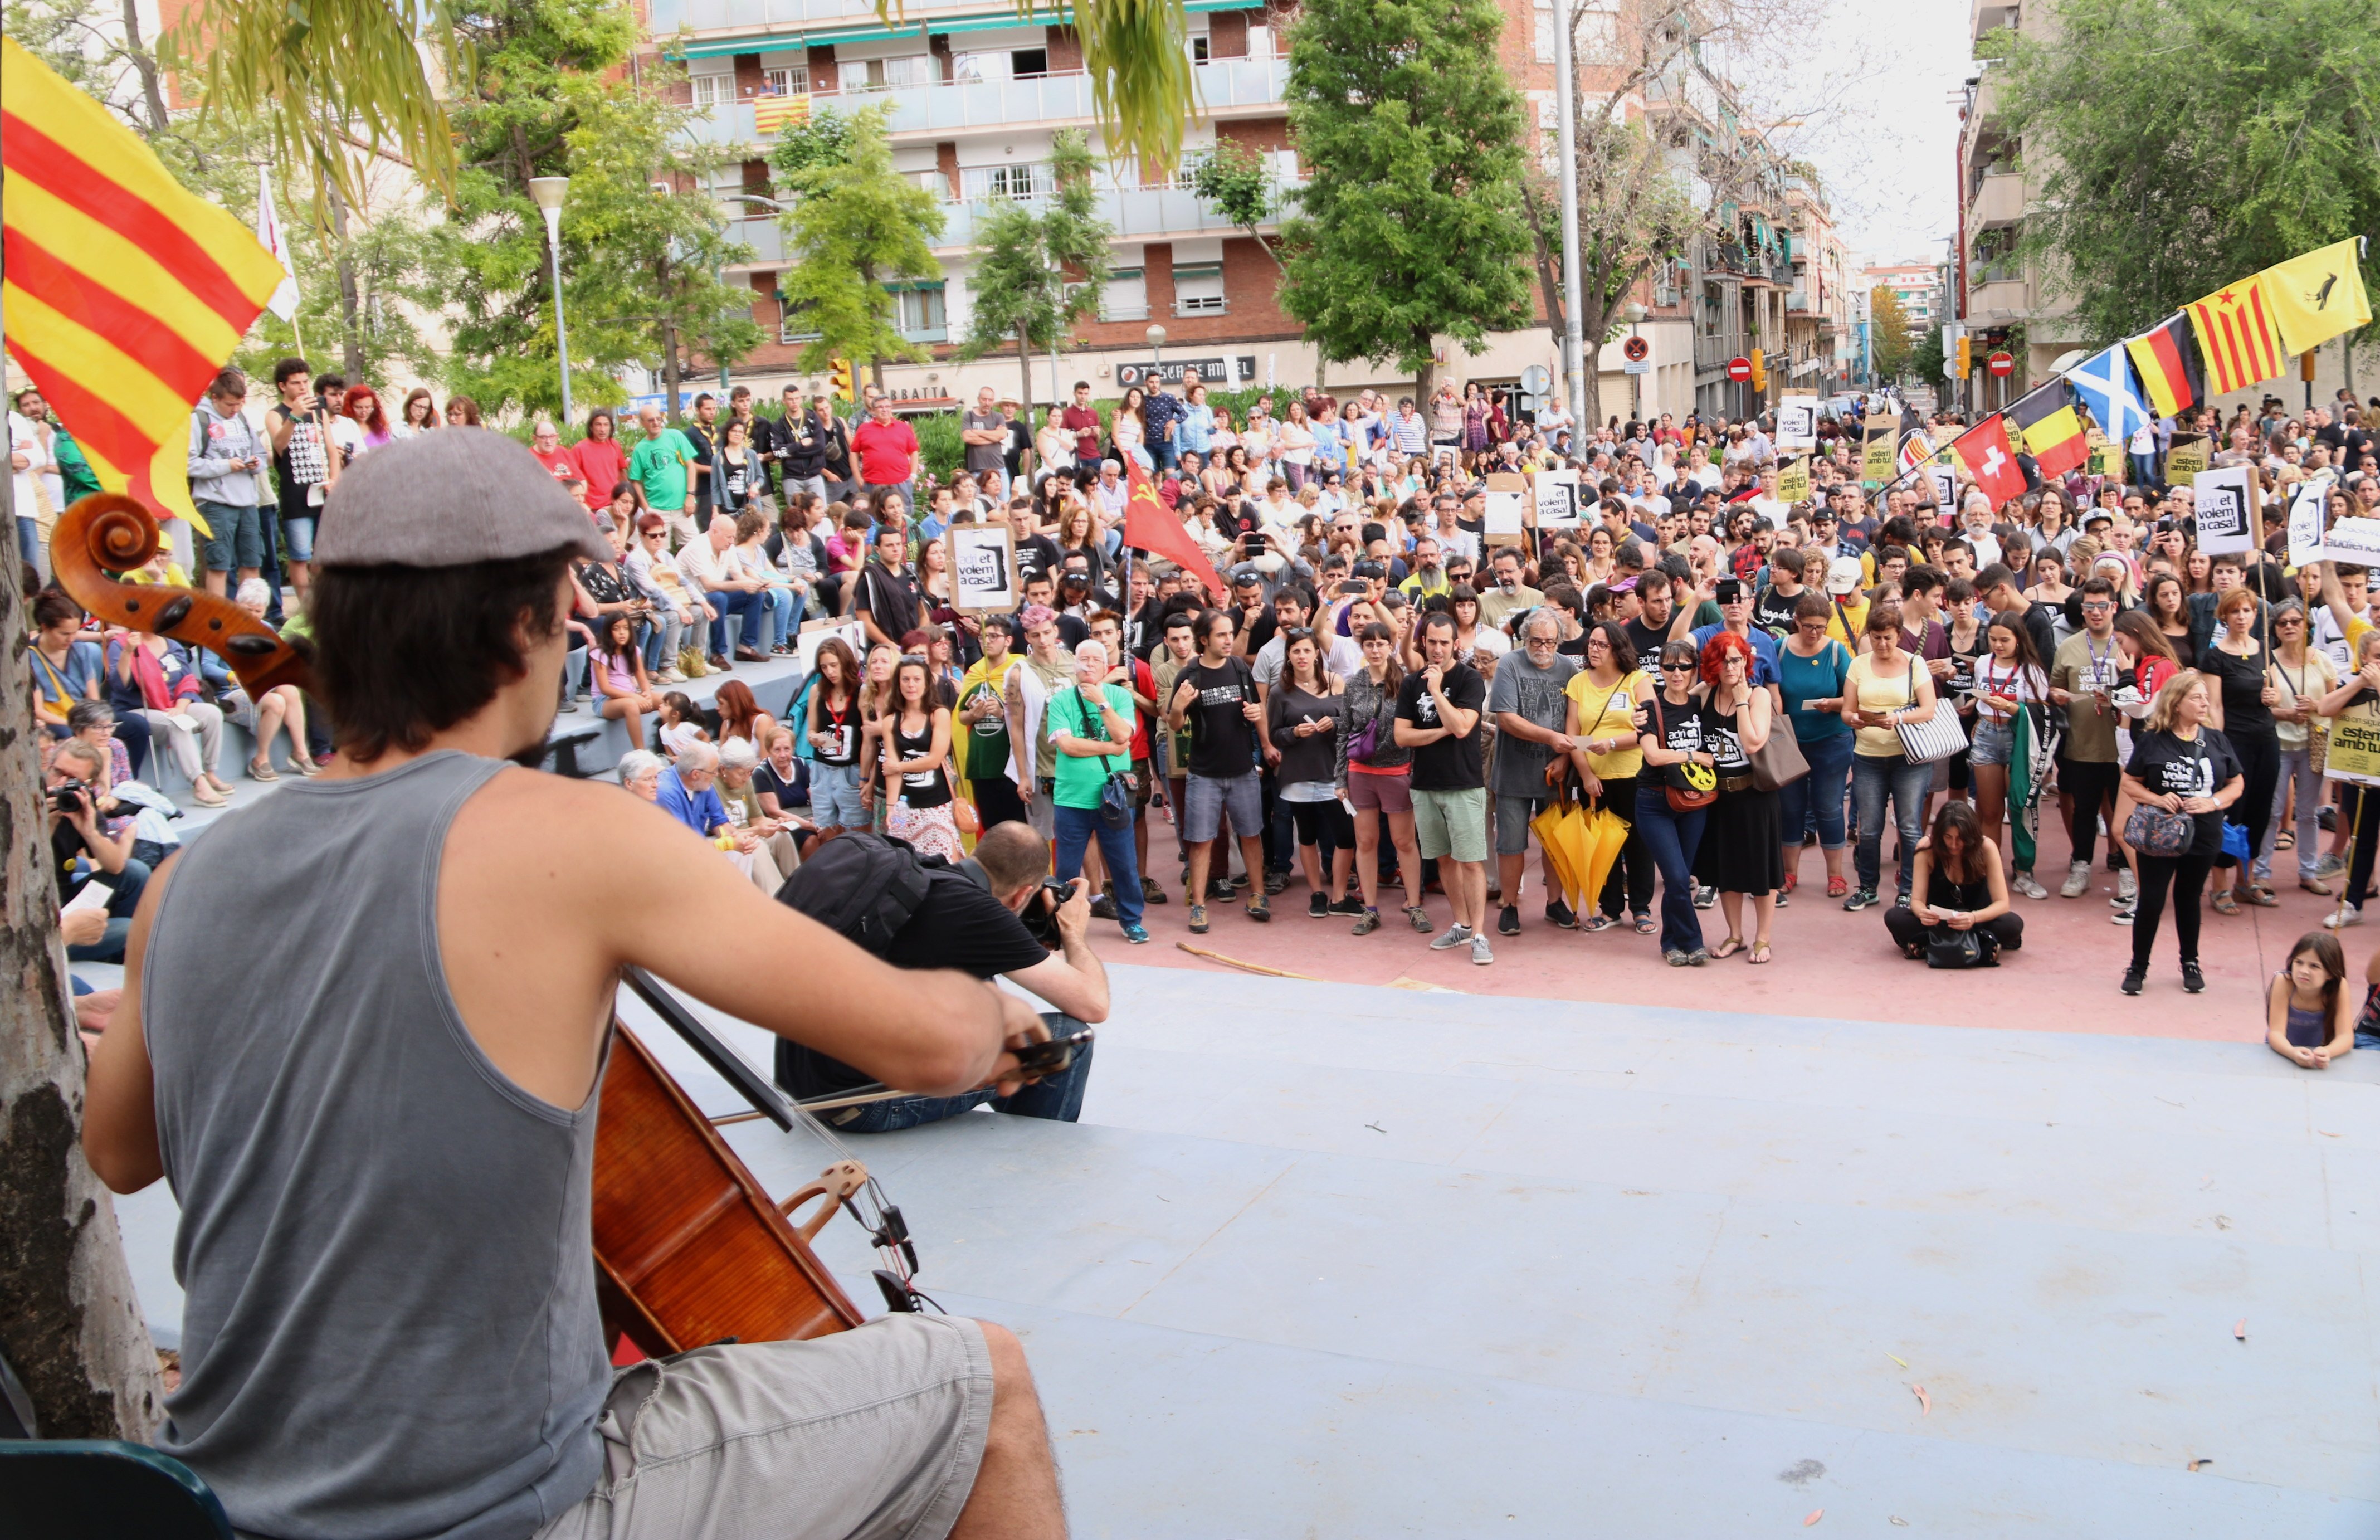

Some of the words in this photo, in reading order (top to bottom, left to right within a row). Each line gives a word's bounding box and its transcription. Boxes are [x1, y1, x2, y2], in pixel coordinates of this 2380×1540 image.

[1207, 361, 1251, 377] ANEL
[1538, 498, 1567, 506] volem
[2220, 495, 2231, 505] et
[1545, 505, 1568, 514] casa!
[2197, 508, 2234, 519] volem
[2199, 523, 2206, 531] a
[2207, 516, 2237, 530] casa!
[979, 553, 991, 563] et
[958, 565, 994, 575] volem
[960, 577, 967, 585] a
[969, 573, 996, 585] casa!
[1638, 654, 1655, 664] adri
[1668, 729, 1686, 740] adri
[1686, 727, 1698, 738] et
[1704, 733, 1721, 743] adri
[2042, 727, 2051, 749] RESPECT
[1666, 737, 1698, 748] volem
[2334, 737, 2366, 751] amb
[2165, 761, 2186, 772] adri
